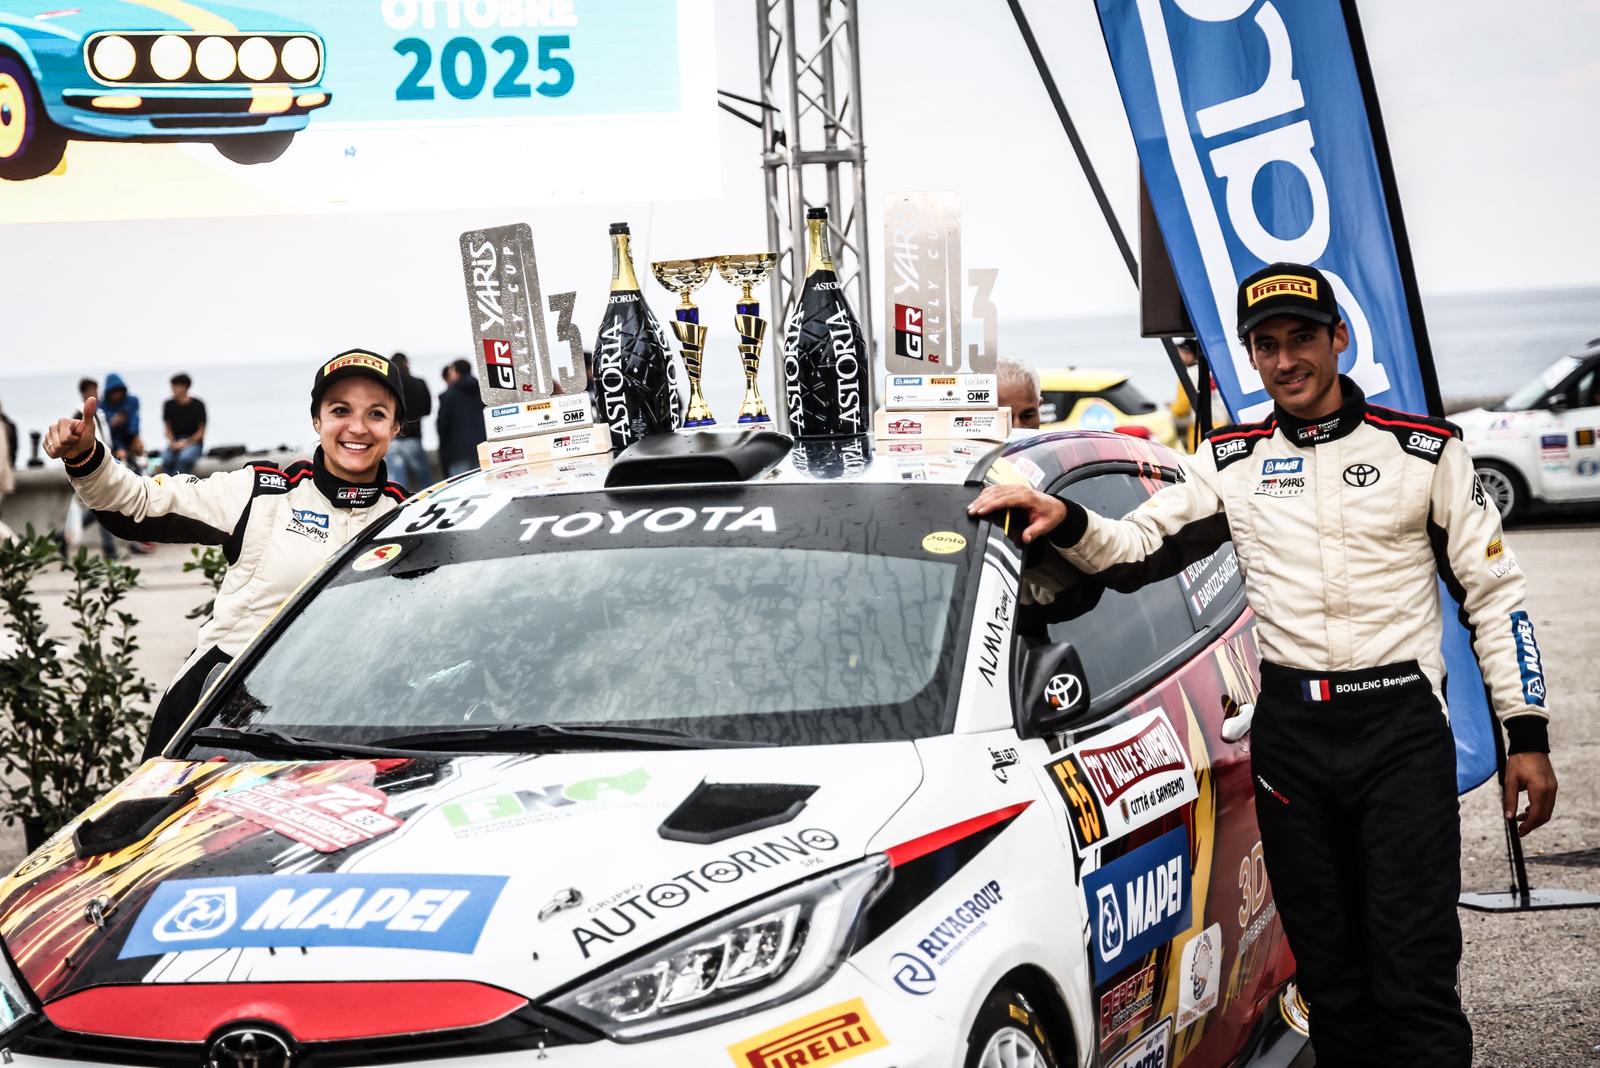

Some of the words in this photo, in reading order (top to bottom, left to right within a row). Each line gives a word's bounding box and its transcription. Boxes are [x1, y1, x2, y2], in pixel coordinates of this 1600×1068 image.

[393, 35, 575, 101] 2025
[503, 246, 519, 293] CUP
[894, 222, 920, 294] YAR
[469, 240, 504, 331] YARIS
[1252, 279, 1312, 300] PIRELLI
[548, 291, 588, 395] 3
[928, 280, 939, 363] RALLY
[968, 268, 999, 374] 3
[329, 356, 383, 373] PIRELLI
[493, 341, 515, 389] GR
[600, 315, 631, 445] ASTORIA
[648, 311, 680, 431] ASTORIA
[784, 302, 805, 435] ASTORIA
[826, 301, 860, 433] ASTORIA
[563, 411, 584, 422] OMP
[967, 392, 990, 400] OMP
[1216, 441, 1247, 456] OMP
[1300, 431, 1317, 439] GR
[1314, 433, 1330, 441] Italy
[1409, 434, 1441, 451] OMP
[1279, 477, 1306, 488] YARIS
[405, 494, 490, 532] 55
[519, 506, 777, 541] TOYOTA
[978, 621, 1004, 688] ALMA
[1517, 620, 1541, 673] MAPEI
[1336, 680, 1381, 693] BOULENC
[1383, 673, 1420, 687] Benjamin
[1104, 744, 1143, 789] RALLYE
[1136, 723, 1183, 770] SANREMO
[1053, 759, 1101, 844] 55
[1130, 790, 1149, 816] CITTÀ
[1149, 791, 1156, 805] di
[1155, 777, 1185, 803] SANREMO
[283, 808, 360, 842] SANREMO
[355, 815, 381, 827] 55
[800, 857, 824, 869] SPA
[1238, 841, 1268, 928] 3D
[241, 887, 469, 932] MAPEI
[572, 828, 839, 959] AUTOTORINO
[587, 883, 644, 914] GRUPPO
[1127, 855, 1182, 941] MAPEI
[917, 879, 1003, 959] RIVAGROUP
[745, 1012, 871, 1068] PIRELLI
